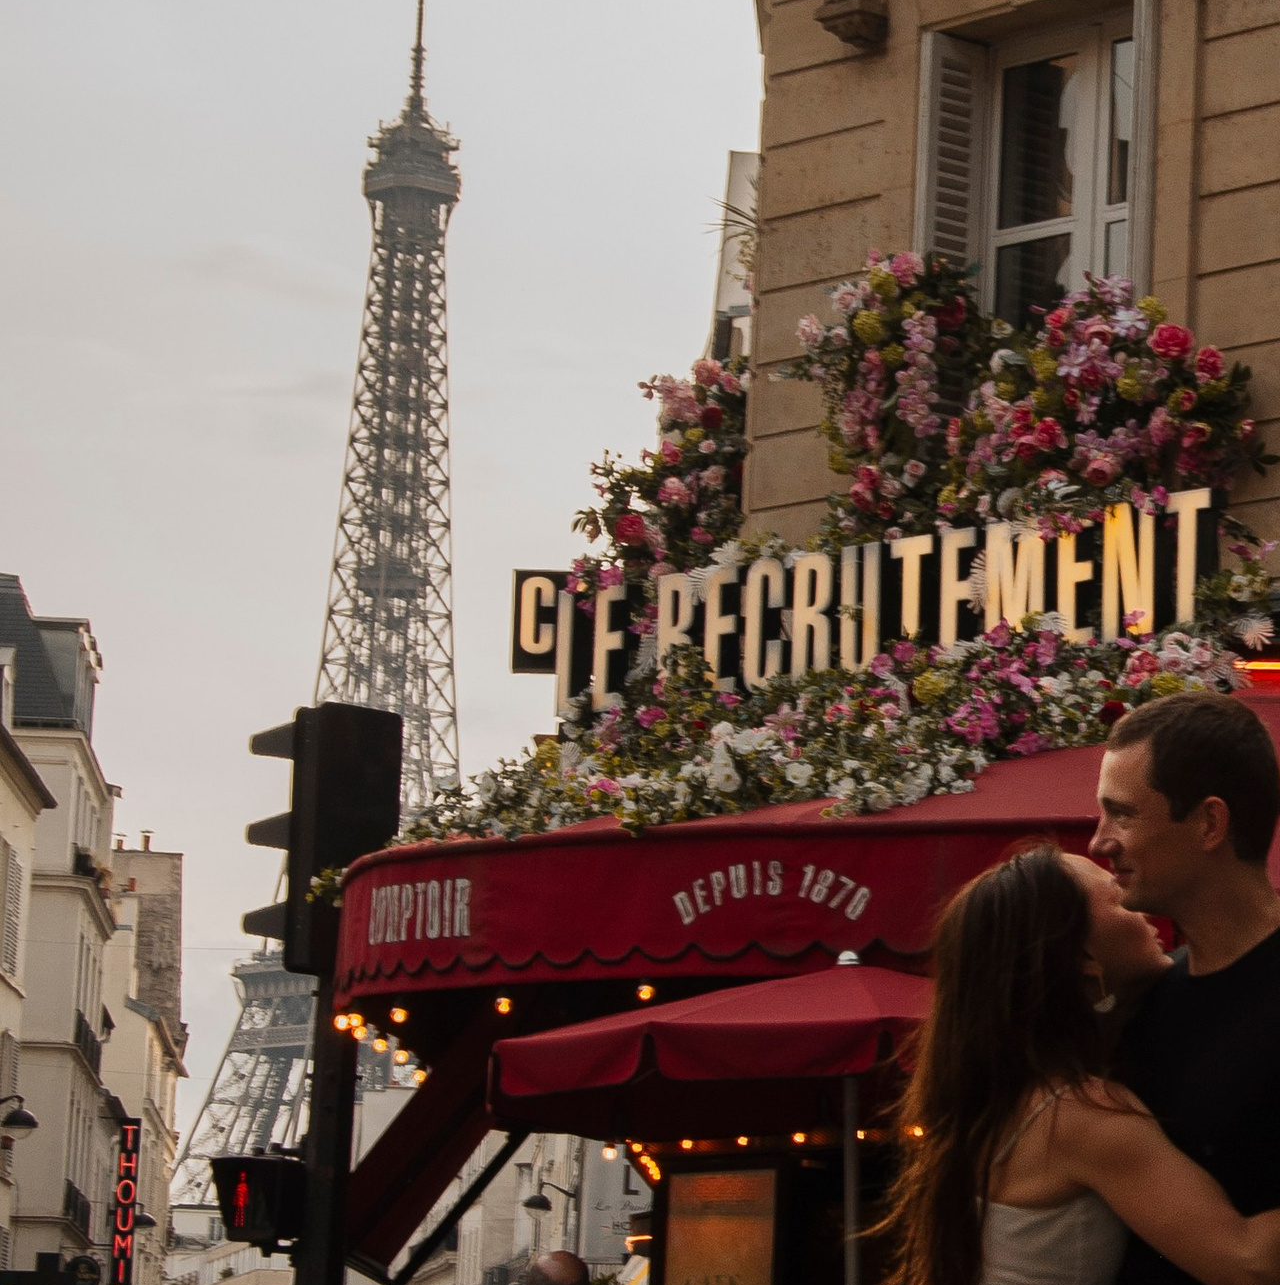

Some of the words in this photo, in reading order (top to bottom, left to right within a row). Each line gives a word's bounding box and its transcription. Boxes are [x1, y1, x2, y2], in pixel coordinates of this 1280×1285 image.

[555, 584, 627, 716] LE
[656, 487, 1212, 694] RECRUTEMENT
[671, 861, 784, 926] DEPUIS
[797, 863, 873, 921] 1870
